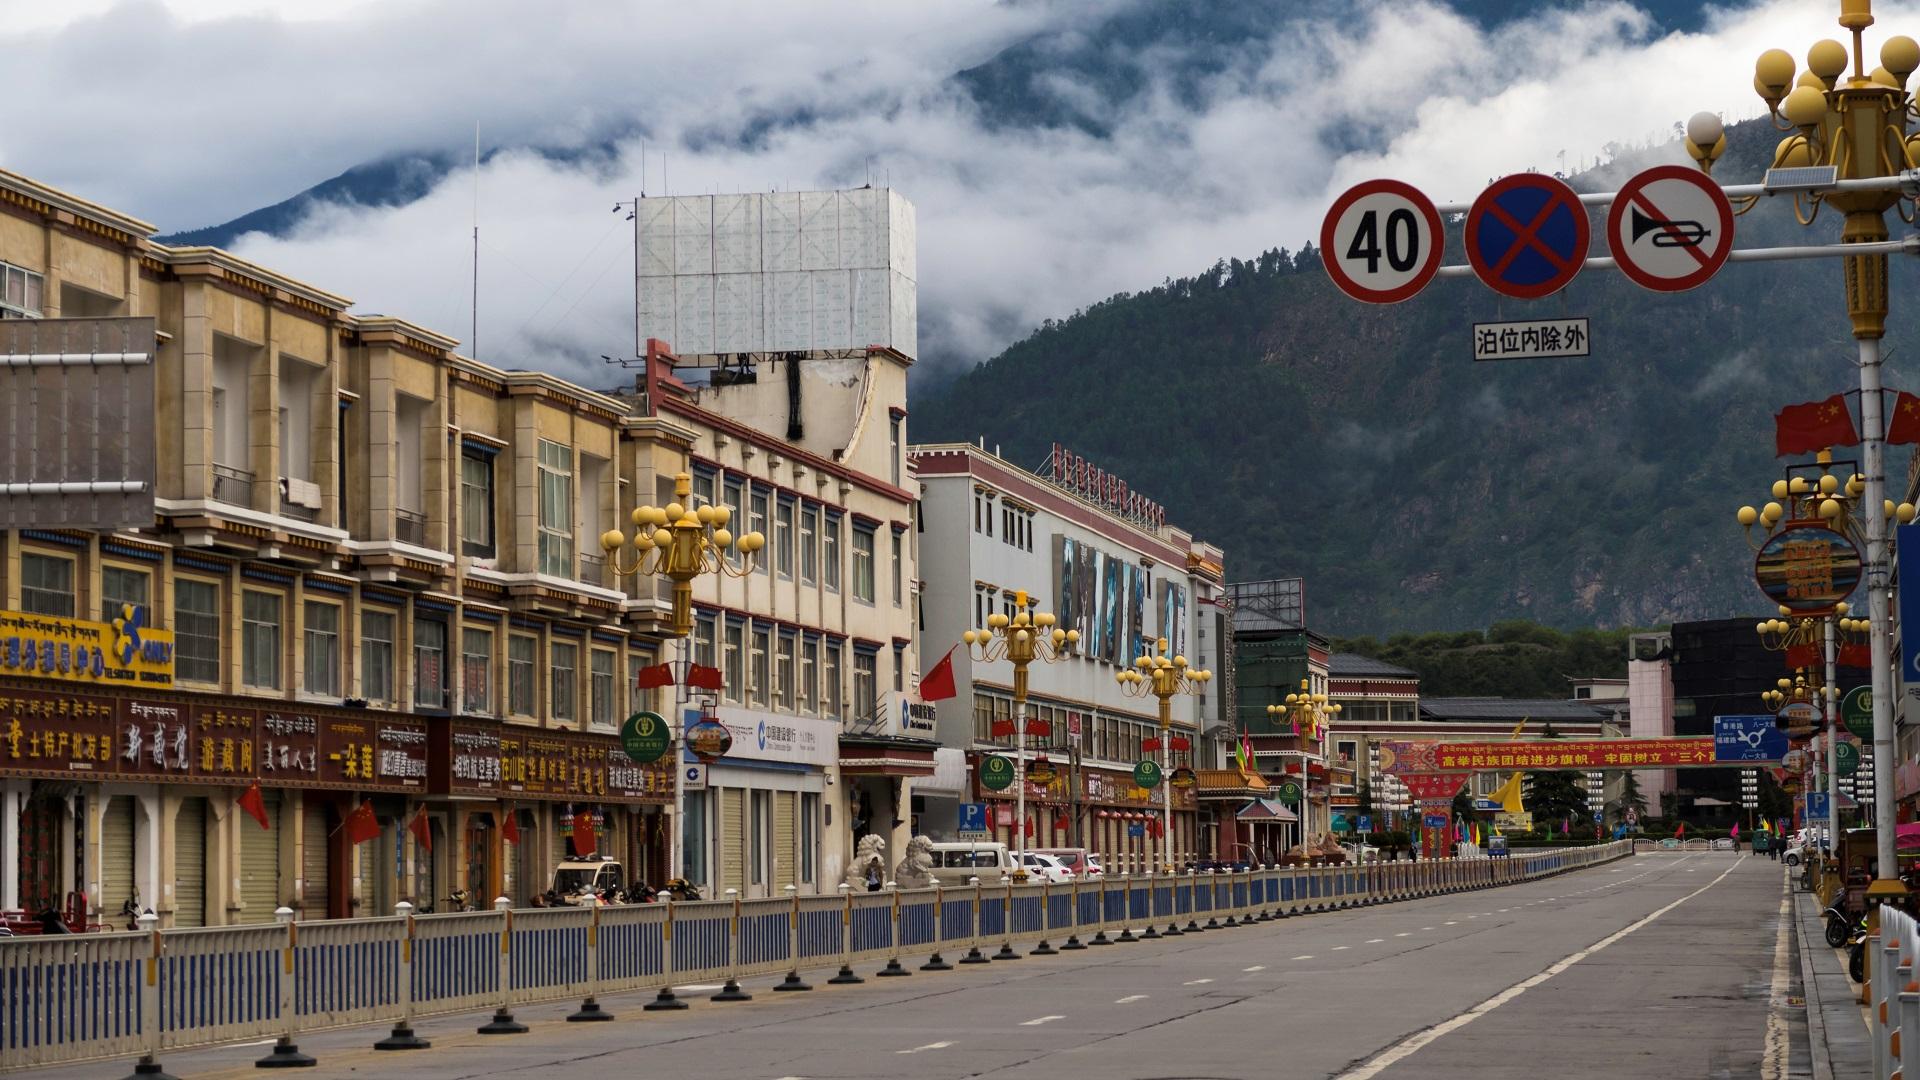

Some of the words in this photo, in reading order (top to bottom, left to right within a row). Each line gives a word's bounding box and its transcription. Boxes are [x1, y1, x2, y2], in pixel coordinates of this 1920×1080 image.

[1346, 208, 1419, 273] 40
[1477, 325, 1586, 355] 泊位内除外
[0, 637, 105, 678] 课外辅导中心
[29, 731, 111, 761] 土特产批发部
[766, 725, 797, 743] 中国建设银行
[264, 740, 316, 772] 美丽人生
[329, 744, 373, 779] 一朵莲
[455, 754, 500, 781] 相约航空票务
[966, 805, 978, 821] P
[1814, 794, 1825, 809] P
[1360, 816, 1367, 824] P
